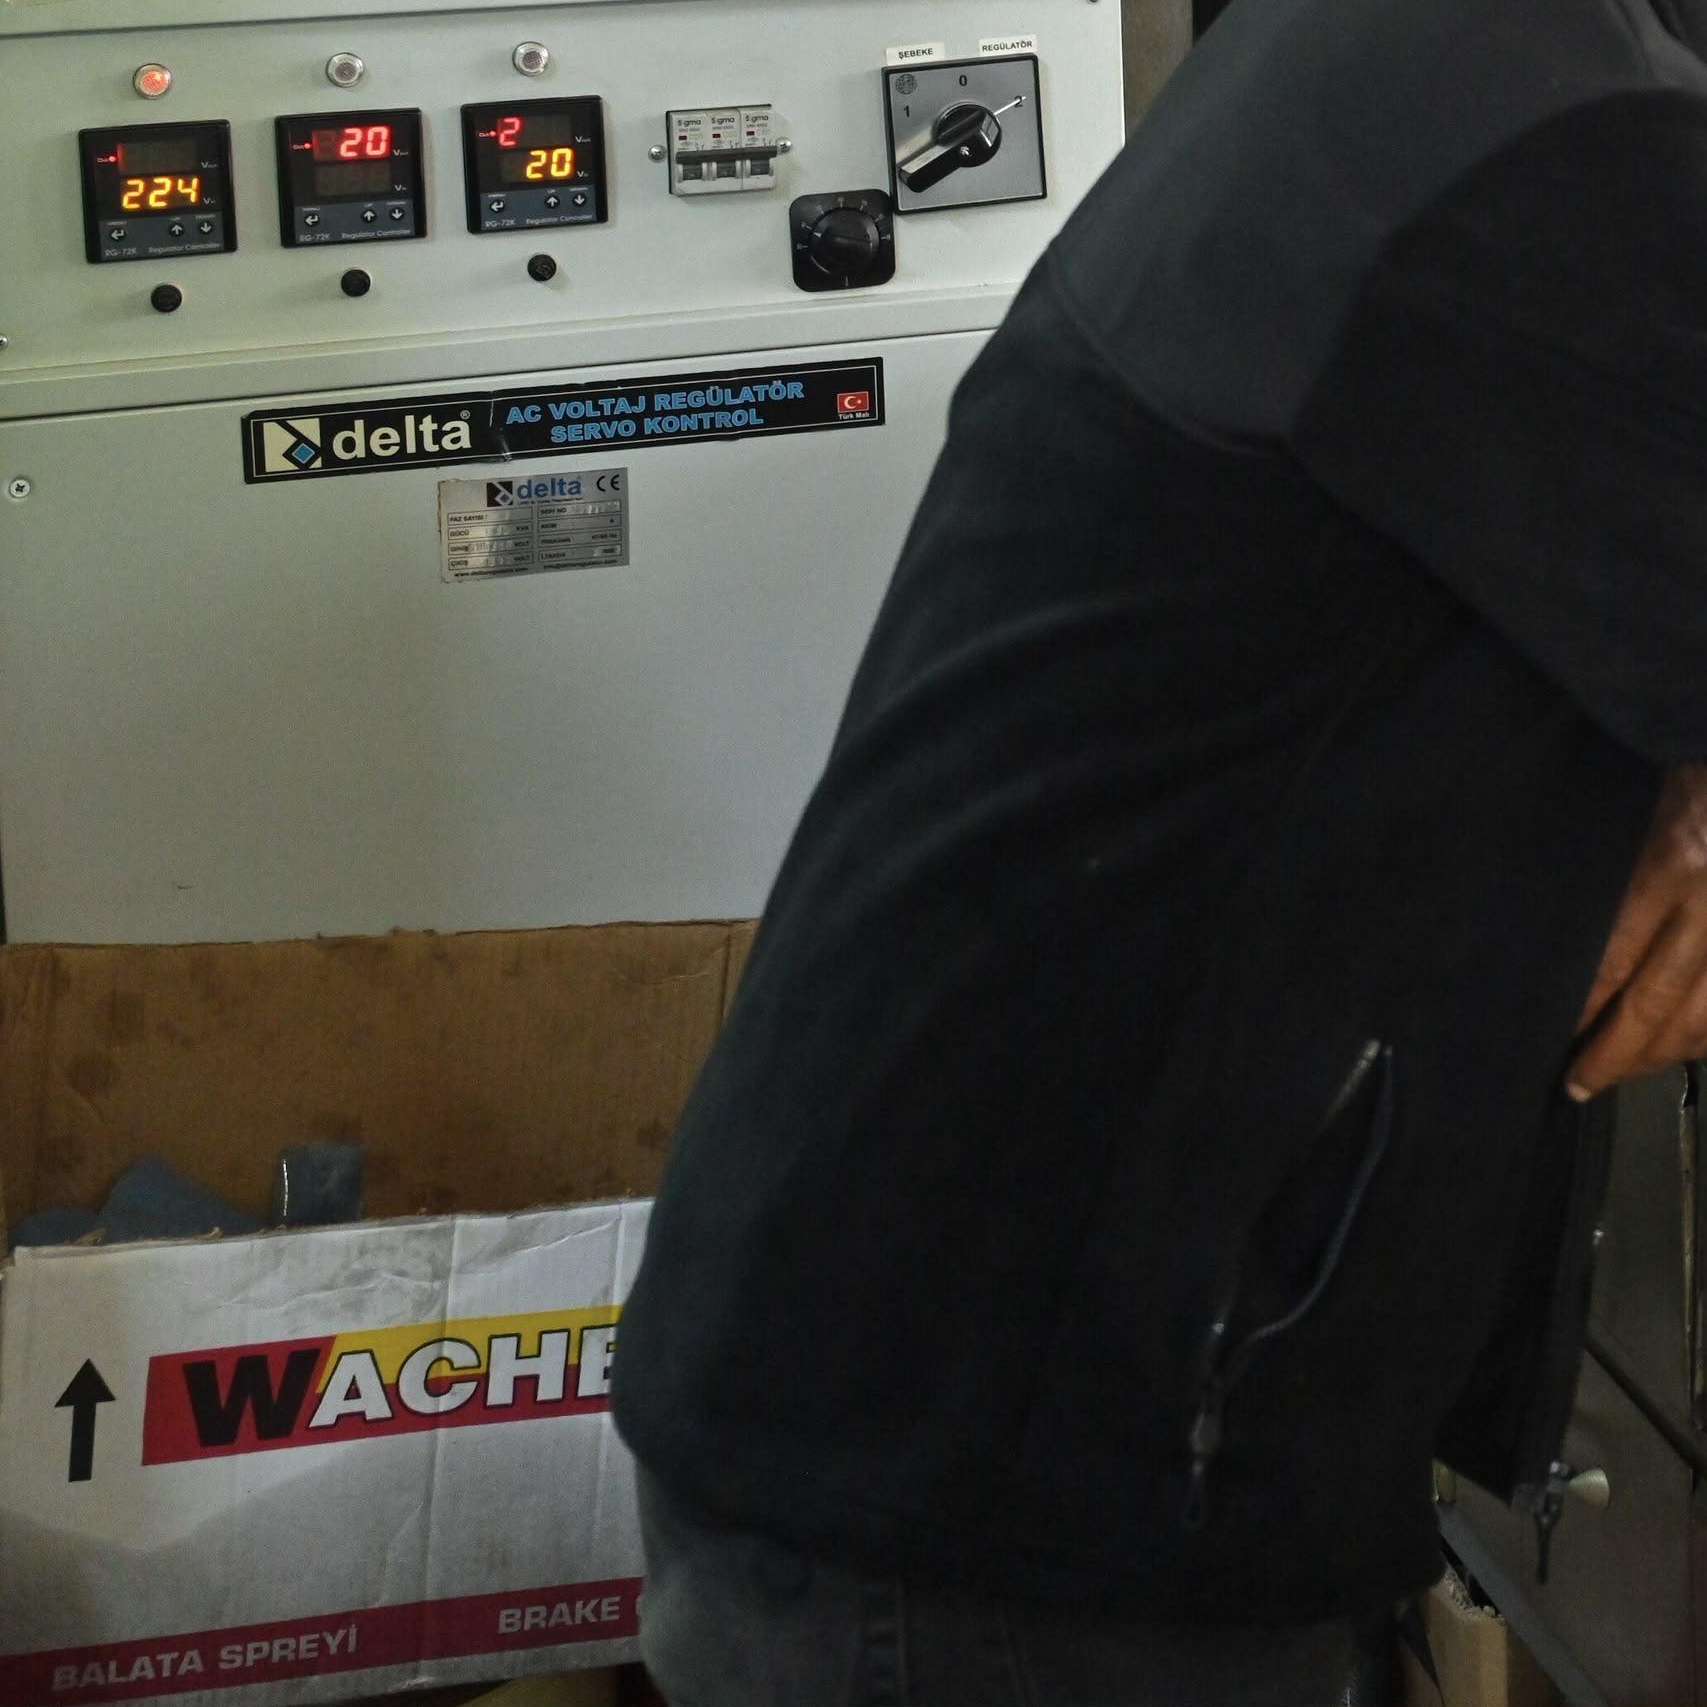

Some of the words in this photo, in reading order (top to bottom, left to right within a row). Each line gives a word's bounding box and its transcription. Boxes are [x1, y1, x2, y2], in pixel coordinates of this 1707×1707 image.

[898, 48, 934, 60] ŞEBEKE
[982, 40, 1033, 52] REGÜLATÖR
[958, 74, 968, 87] 0
[903, 105, 911, 118] 1
[339, 125, 389, 158] 20
[499, 117, 521, 147] 2
[526, 148, 573, 179] 20
[122, 177, 199, 209] 224
[505, 404, 542, 425] AC
[548, 393, 646, 421] VOLTAJ
[654, 380, 805, 411] REGÜLATÖR
[332, 414, 472, 461] delta
[550, 420, 637, 444] SERVO
[644, 408, 765, 435] KONTROL
[516, 477, 582, 499] delta
[51, 1649, 205, 1692] BALATA
[220, 1624, 359, 1671] SPREYİ
[497, 1595, 621, 1635] BRAKE
